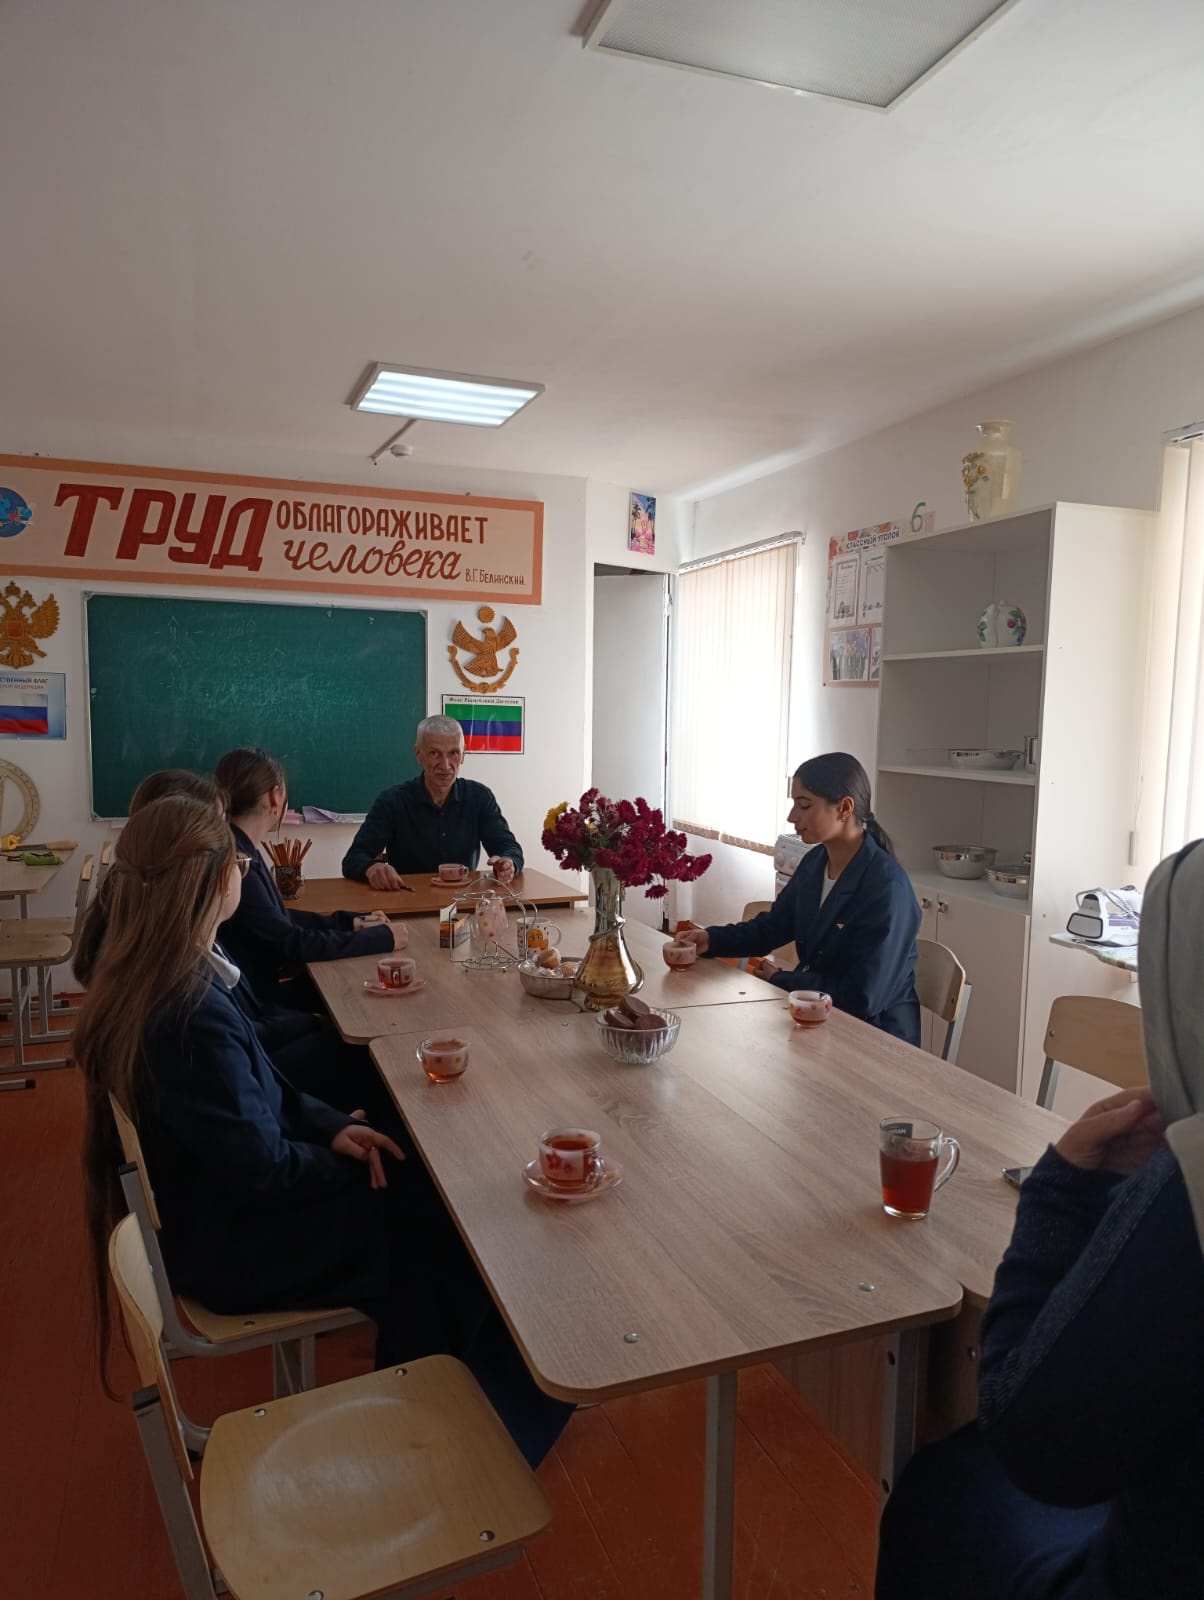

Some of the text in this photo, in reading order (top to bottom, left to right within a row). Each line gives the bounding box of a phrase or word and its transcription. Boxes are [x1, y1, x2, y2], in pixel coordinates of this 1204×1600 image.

[54, 483, 274, 572] ТРУД
[276, 499, 489, 545] ОБЛАГОРАЖИВАЕТ
[911, 501, 927, 533] 6
[283, 538, 463, 581] человека
[845, 528, 900, 550] КЛАССНЫЙ УГОЛОК
